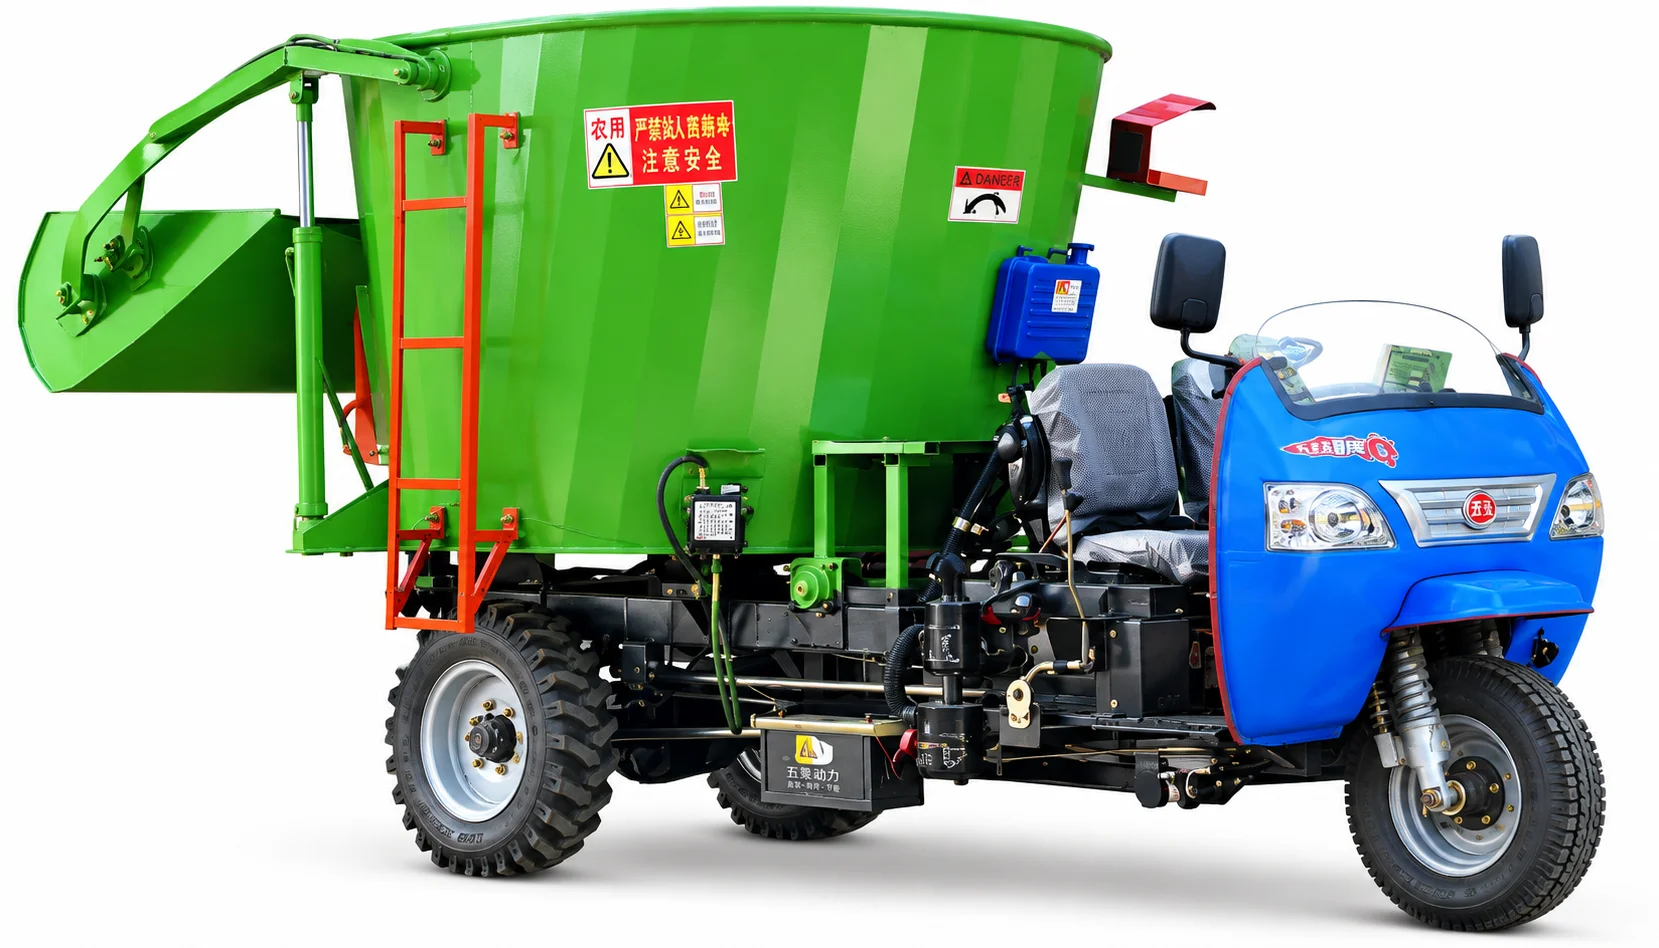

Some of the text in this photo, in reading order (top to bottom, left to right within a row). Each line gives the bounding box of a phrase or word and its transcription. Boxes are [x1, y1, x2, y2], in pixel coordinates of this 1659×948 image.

[591, 117, 625, 140] 农用
[642, 145, 722, 173] 注意安全
